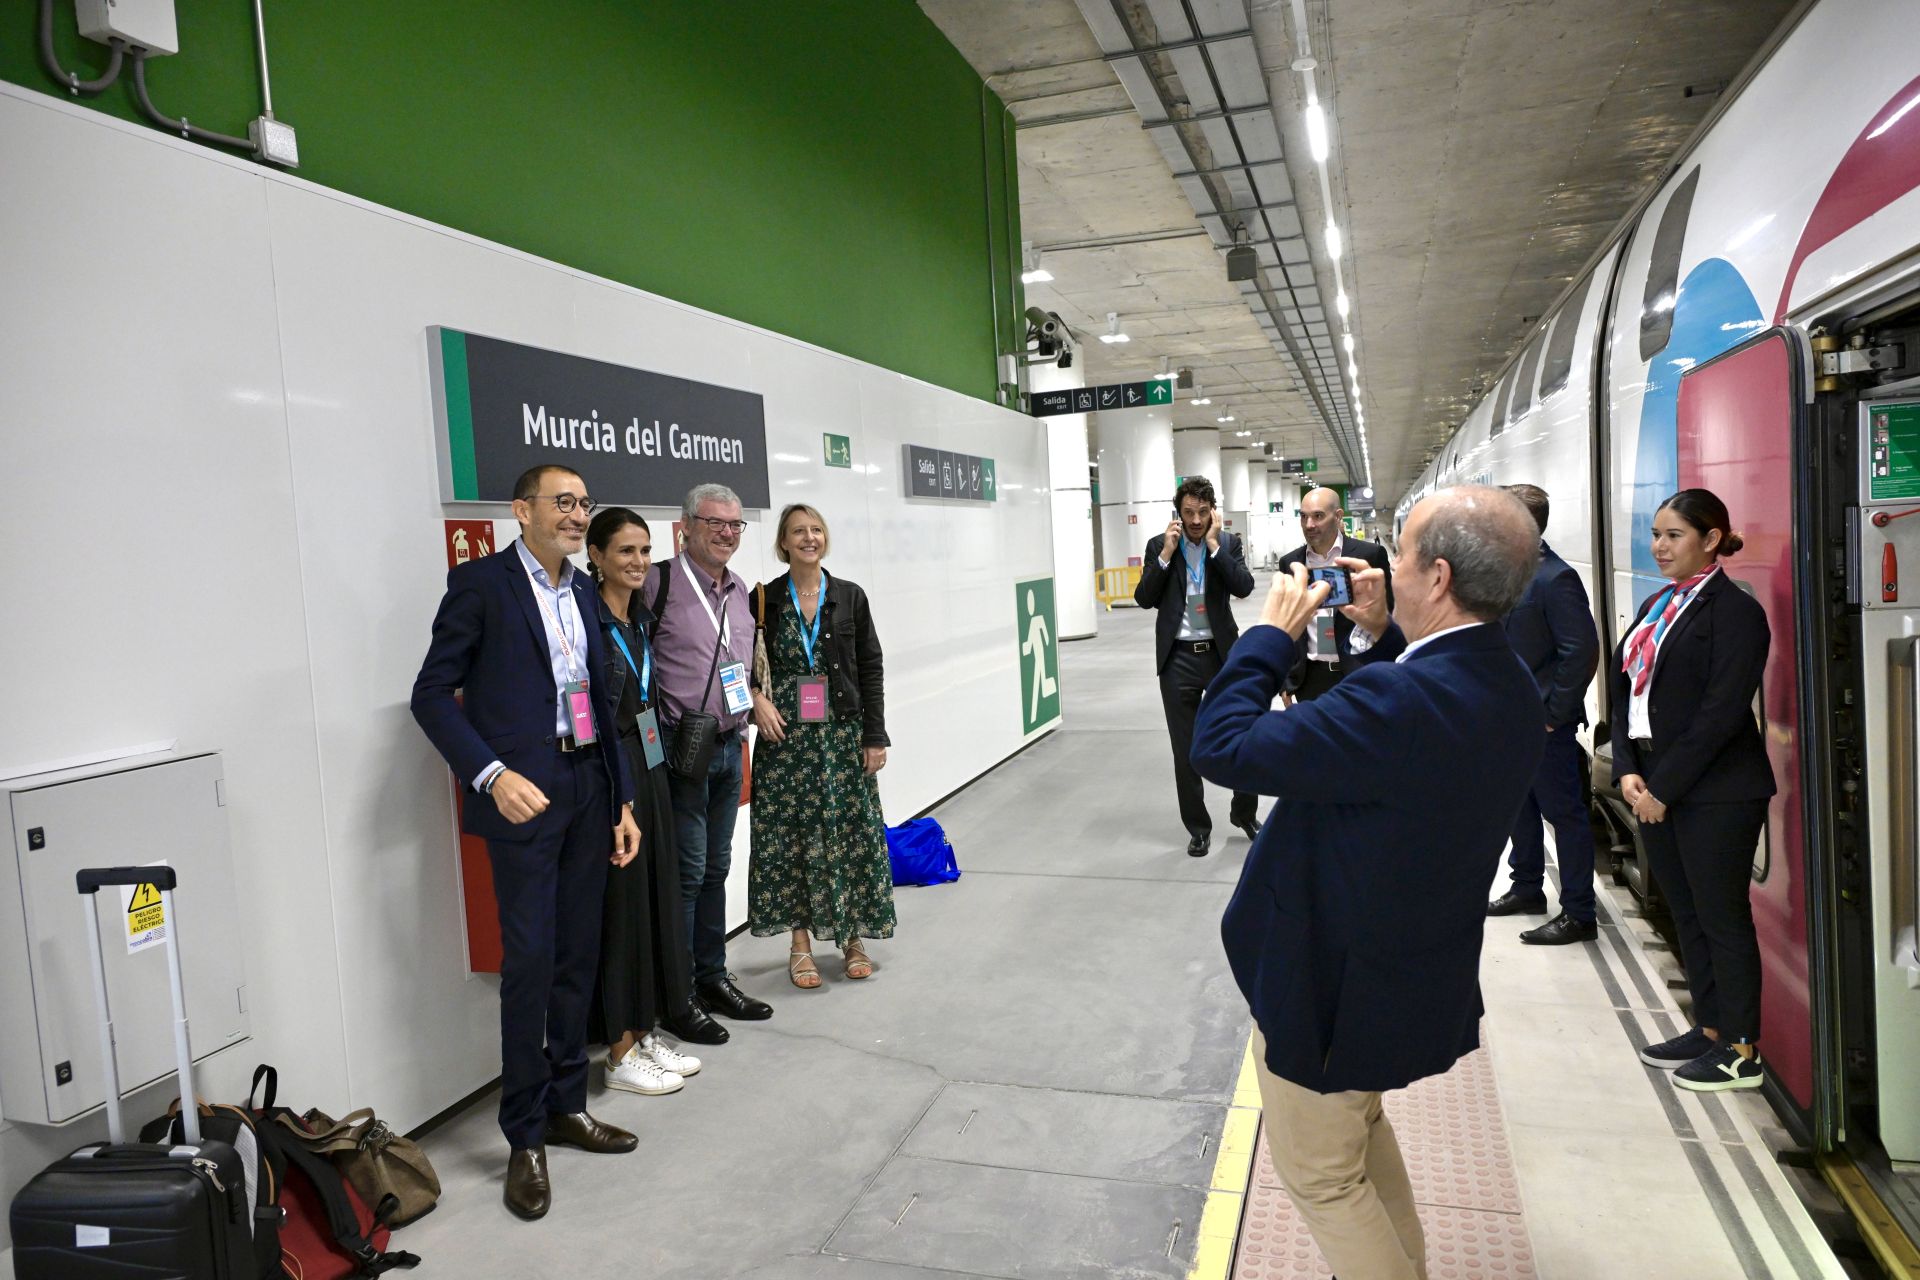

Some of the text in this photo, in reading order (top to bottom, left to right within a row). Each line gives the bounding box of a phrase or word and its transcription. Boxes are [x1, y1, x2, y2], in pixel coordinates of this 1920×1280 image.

[1043, 396, 1066, 406] Salida
[522, 403, 744, 464] Murcia del Carmen
[918, 459, 935, 474] Salida
[135, 906, 161, 919] PELIGRO
[137, 913, 160, 924] RIESGO
